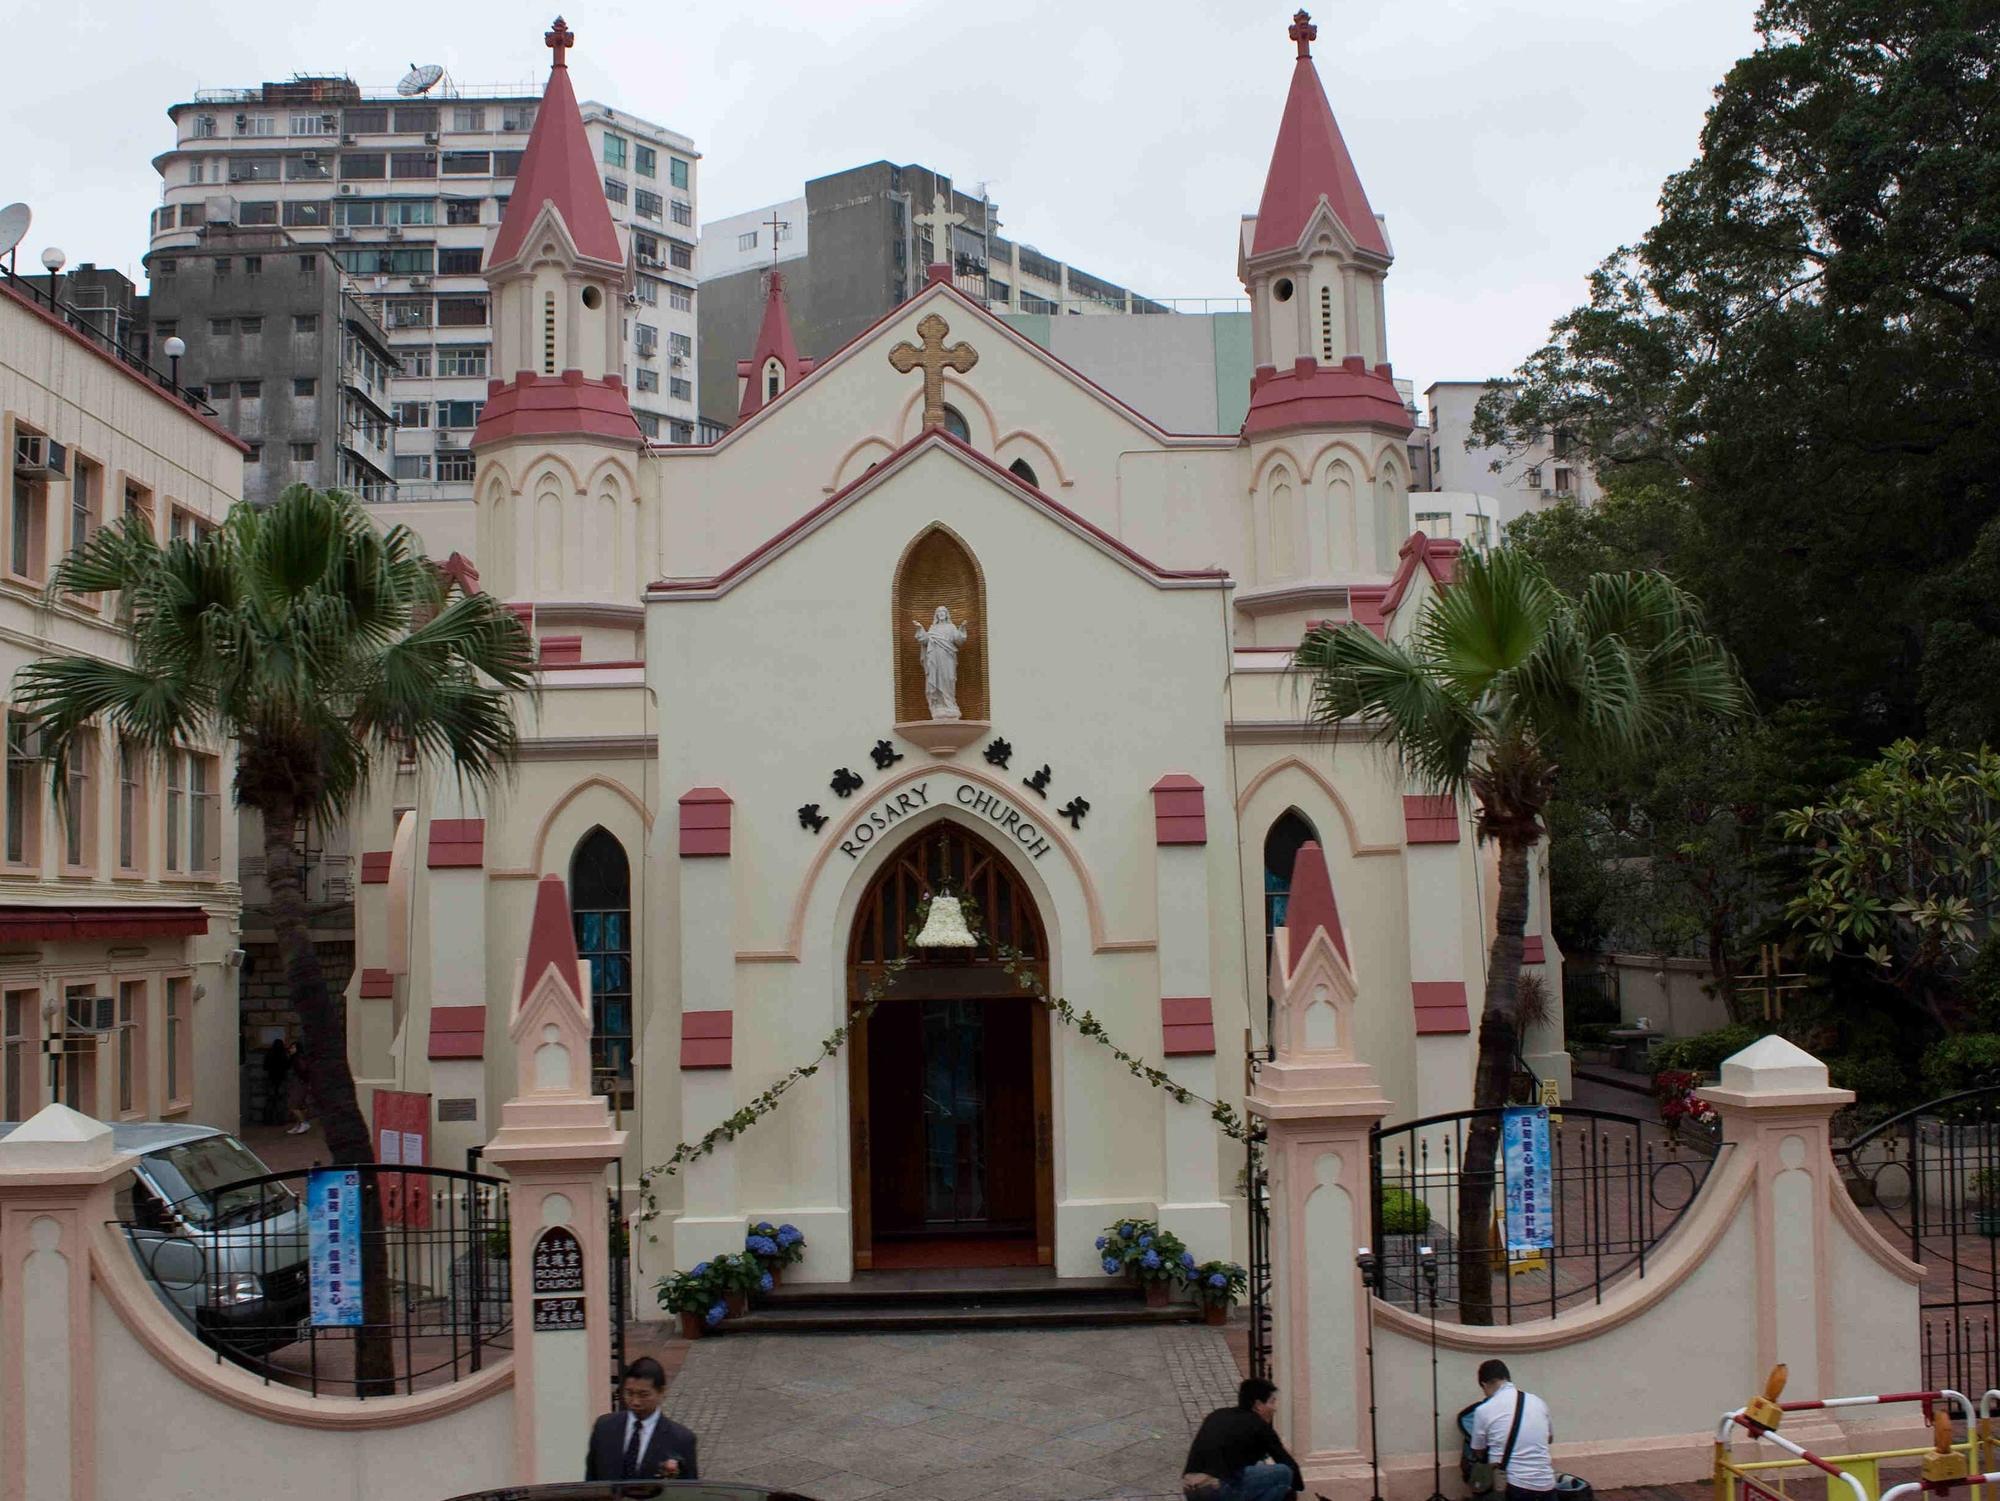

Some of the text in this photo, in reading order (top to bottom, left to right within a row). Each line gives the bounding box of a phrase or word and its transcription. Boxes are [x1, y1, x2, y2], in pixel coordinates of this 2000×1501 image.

[839, 782, 1051, 861] ROSARY CHURCH
[538, 1239, 577, 1252] 天主教
[536, 1252, 580, 1267] 玫瑰堂
[535, 1268, 581, 1278] ROSARY
[536, 1278, 581, 1289] CHURCH
